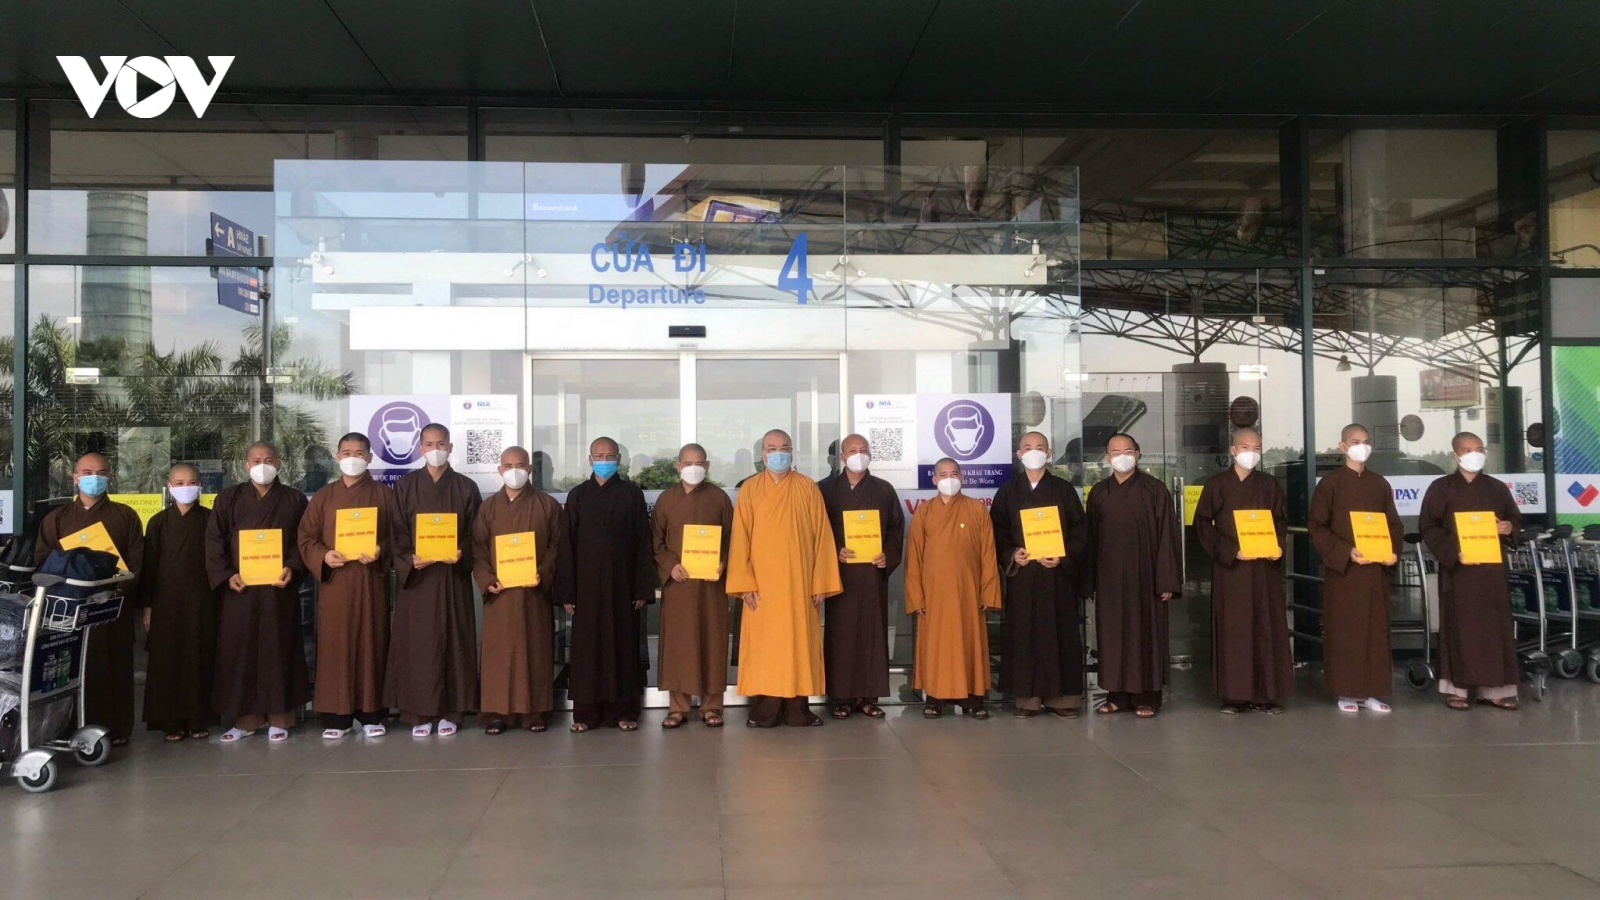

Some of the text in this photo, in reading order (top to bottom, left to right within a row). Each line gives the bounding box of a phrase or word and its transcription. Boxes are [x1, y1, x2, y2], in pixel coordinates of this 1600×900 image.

[590, 230, 814, 305] CỬA ĐI 4
[588, 284, 706, 309] Departure
[983, 468, 1003, 476] TRANG
[969, 477, 977, 485] Be
[978, 477, 995, 485] Worn
[1392, 488, 1420, 500] PAY
